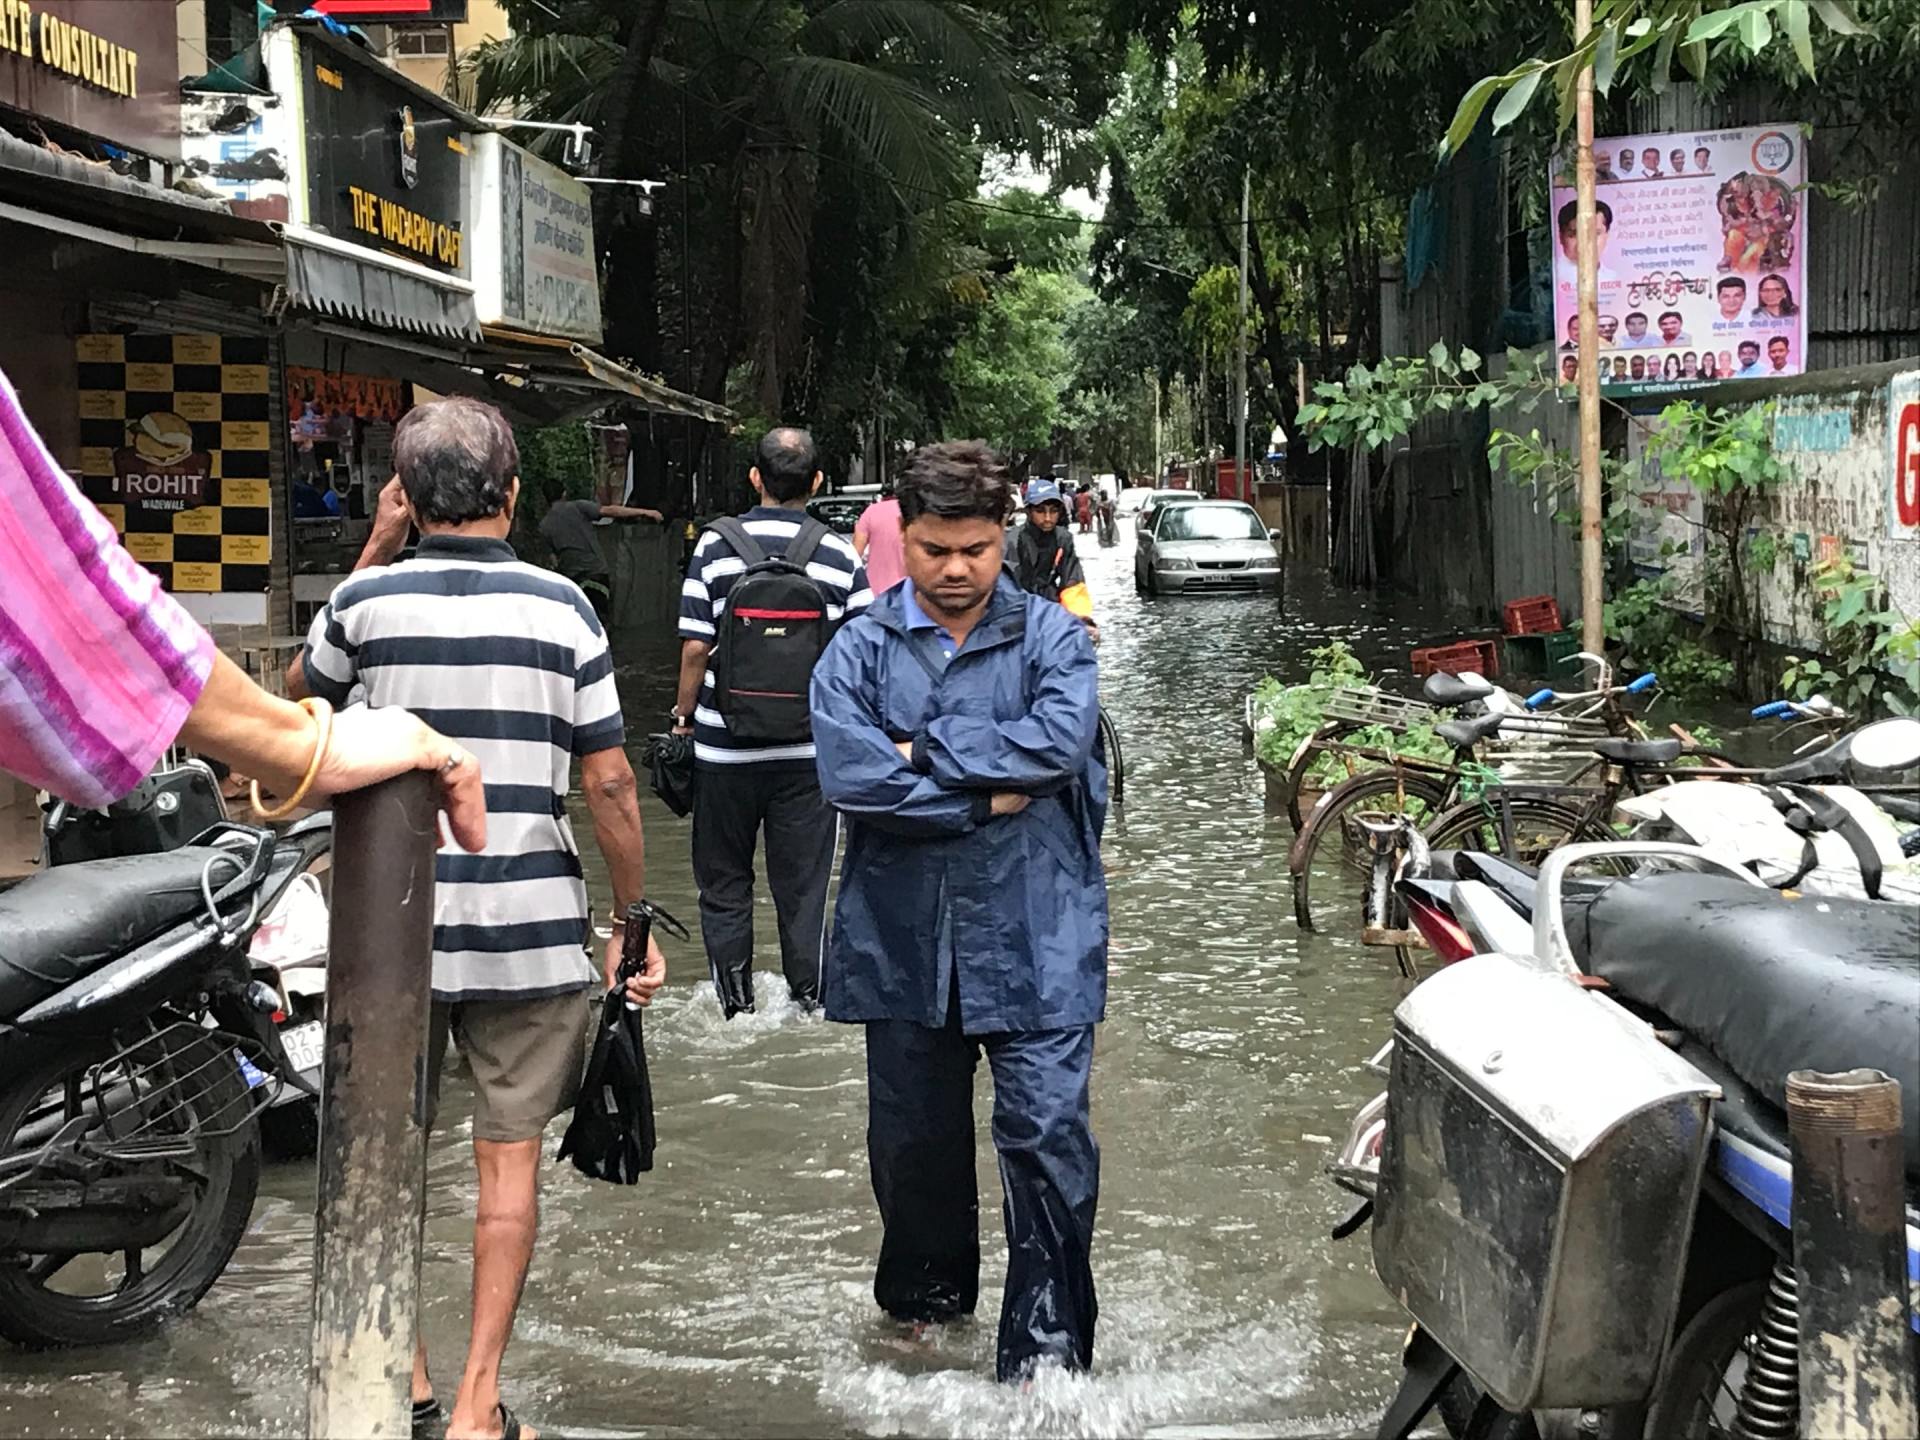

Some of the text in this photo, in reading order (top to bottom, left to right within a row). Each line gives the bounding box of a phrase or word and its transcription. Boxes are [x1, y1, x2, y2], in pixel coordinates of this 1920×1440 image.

[40, 12, 137, 99] CONSULTANT
[349, 186, 379, 235] THE
[379, 198, 436, 257] WADAPAV
[126, 473, 203, 495] ROHIT
[142, 499, 185, 510] WADEWALE
[284, 1030, 309, 1050] 02
